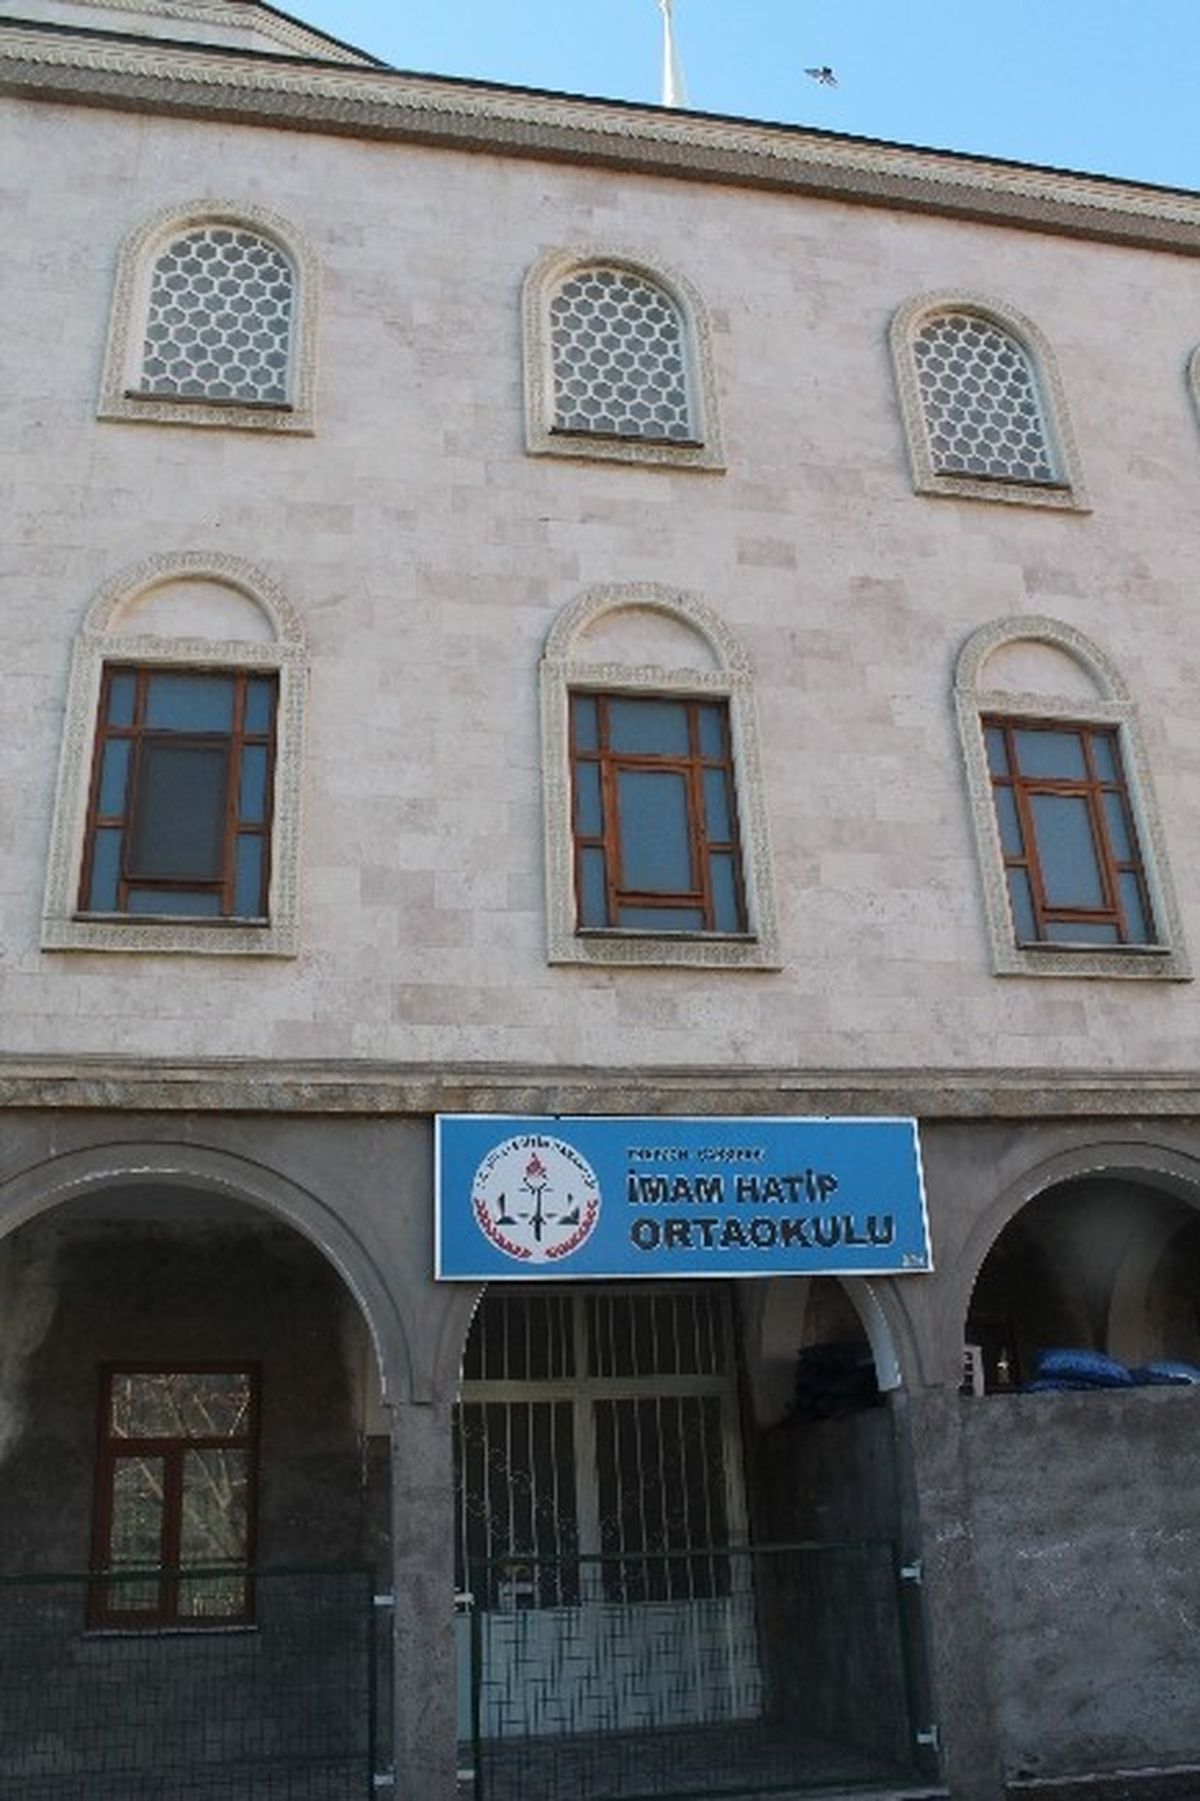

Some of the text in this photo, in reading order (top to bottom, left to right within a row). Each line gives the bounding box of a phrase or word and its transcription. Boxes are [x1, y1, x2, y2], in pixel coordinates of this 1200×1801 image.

[627, 1169, 838, 1204] İMAM HATİP
[631, 1214, 894, 1250] ORTAOKULU
